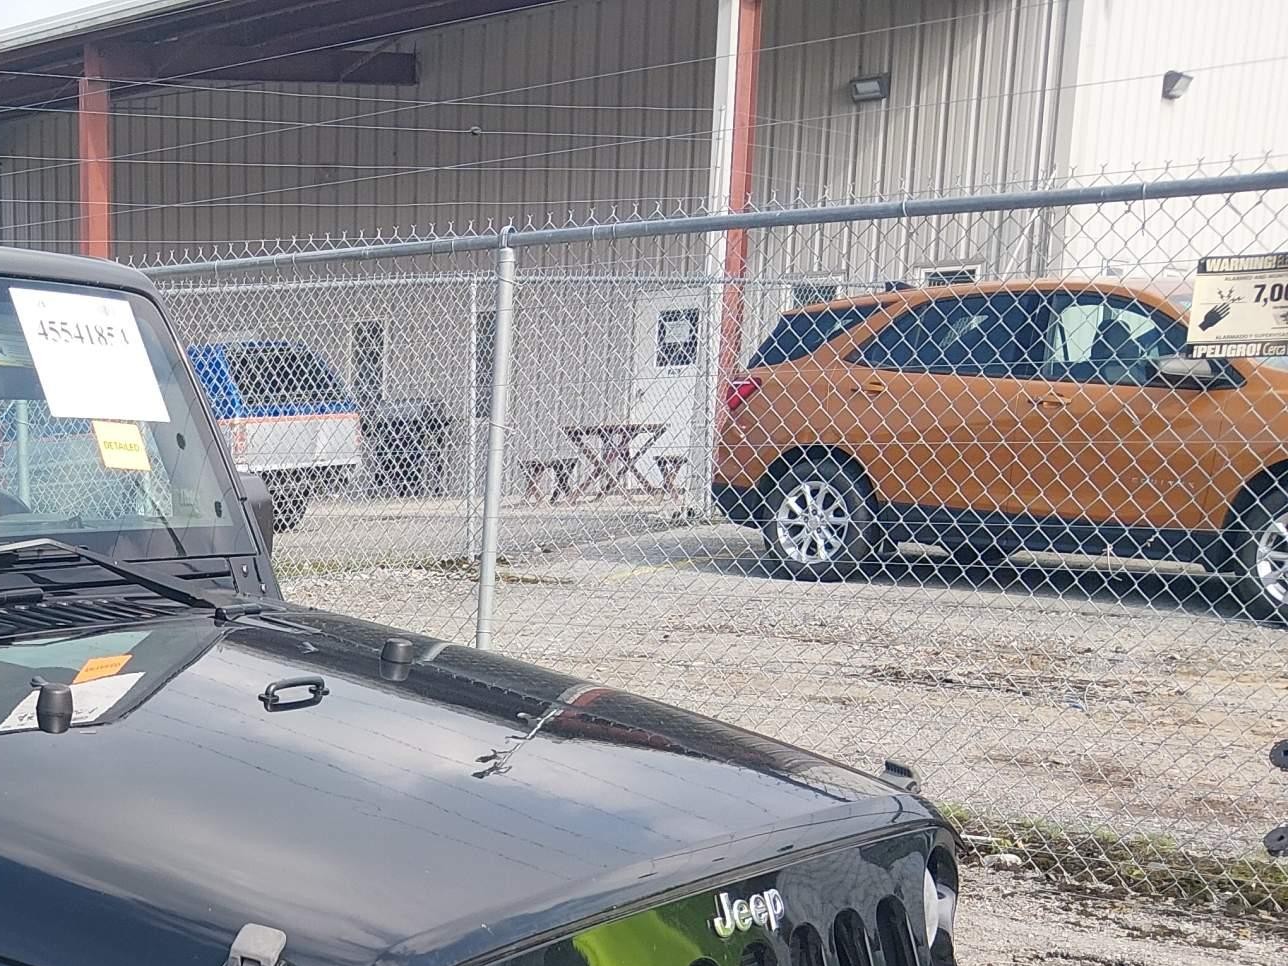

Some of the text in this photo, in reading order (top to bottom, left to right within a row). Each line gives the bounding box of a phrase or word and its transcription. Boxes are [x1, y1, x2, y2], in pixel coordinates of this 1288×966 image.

[1205, 255, 1276, 272] WARNING!
[1254, 283, 1288, 307] 7,0
[1192, 342, 1286, 358] ¡PELIGRO! Cerca
[713, 888, 785, 938] Jeep
